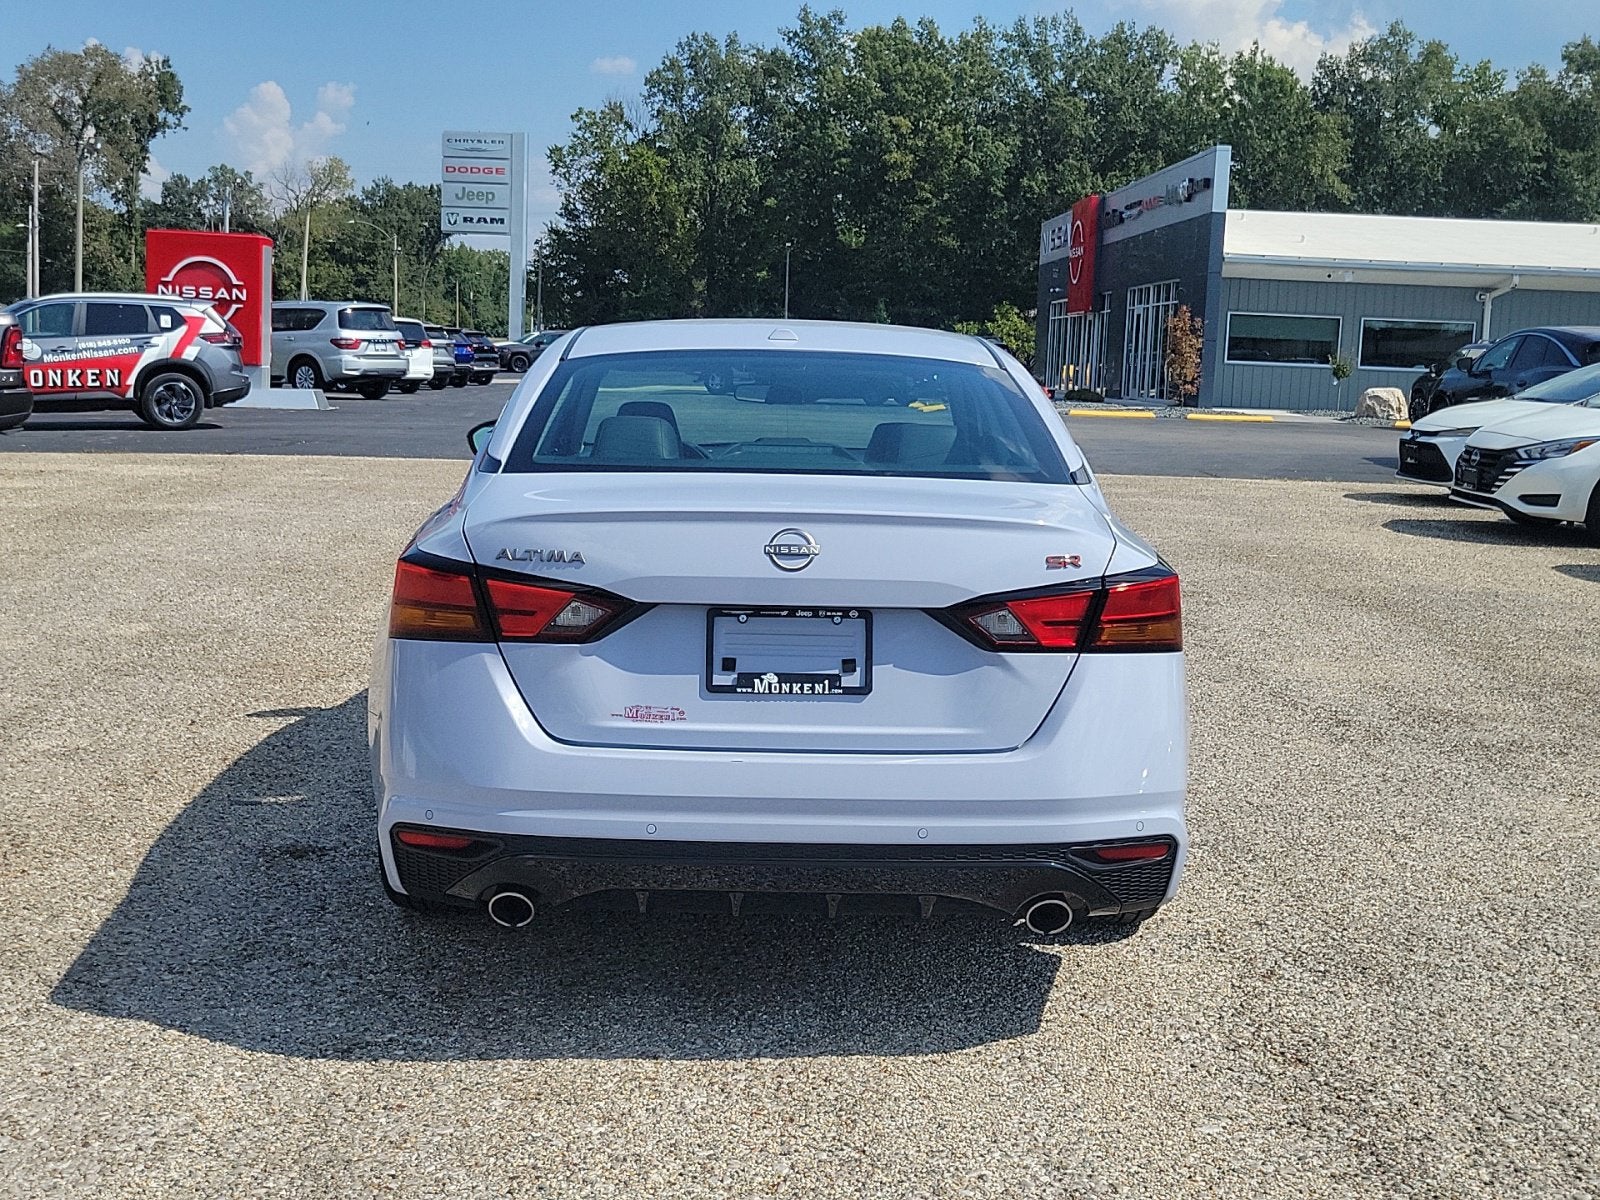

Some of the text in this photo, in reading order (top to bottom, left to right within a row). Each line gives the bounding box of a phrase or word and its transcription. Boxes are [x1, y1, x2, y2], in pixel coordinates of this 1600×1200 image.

[445, 166, 506, 176] DODGE
[455, 186, 496, 204] Jeep
[462, 216, 505, 225] RAM
[157, 284, 247, 301] NISSAN
[43, 346, 138, 363] MonkenNissan.com
[30, 369, 119, 387] ONKEN
[495, 548, 586, 565] ALTIMA
[765, 546, 819, 554] NISSAN
[1045, 555, 1081, 569] SR
[795, 609, 813, 618] Jeep
